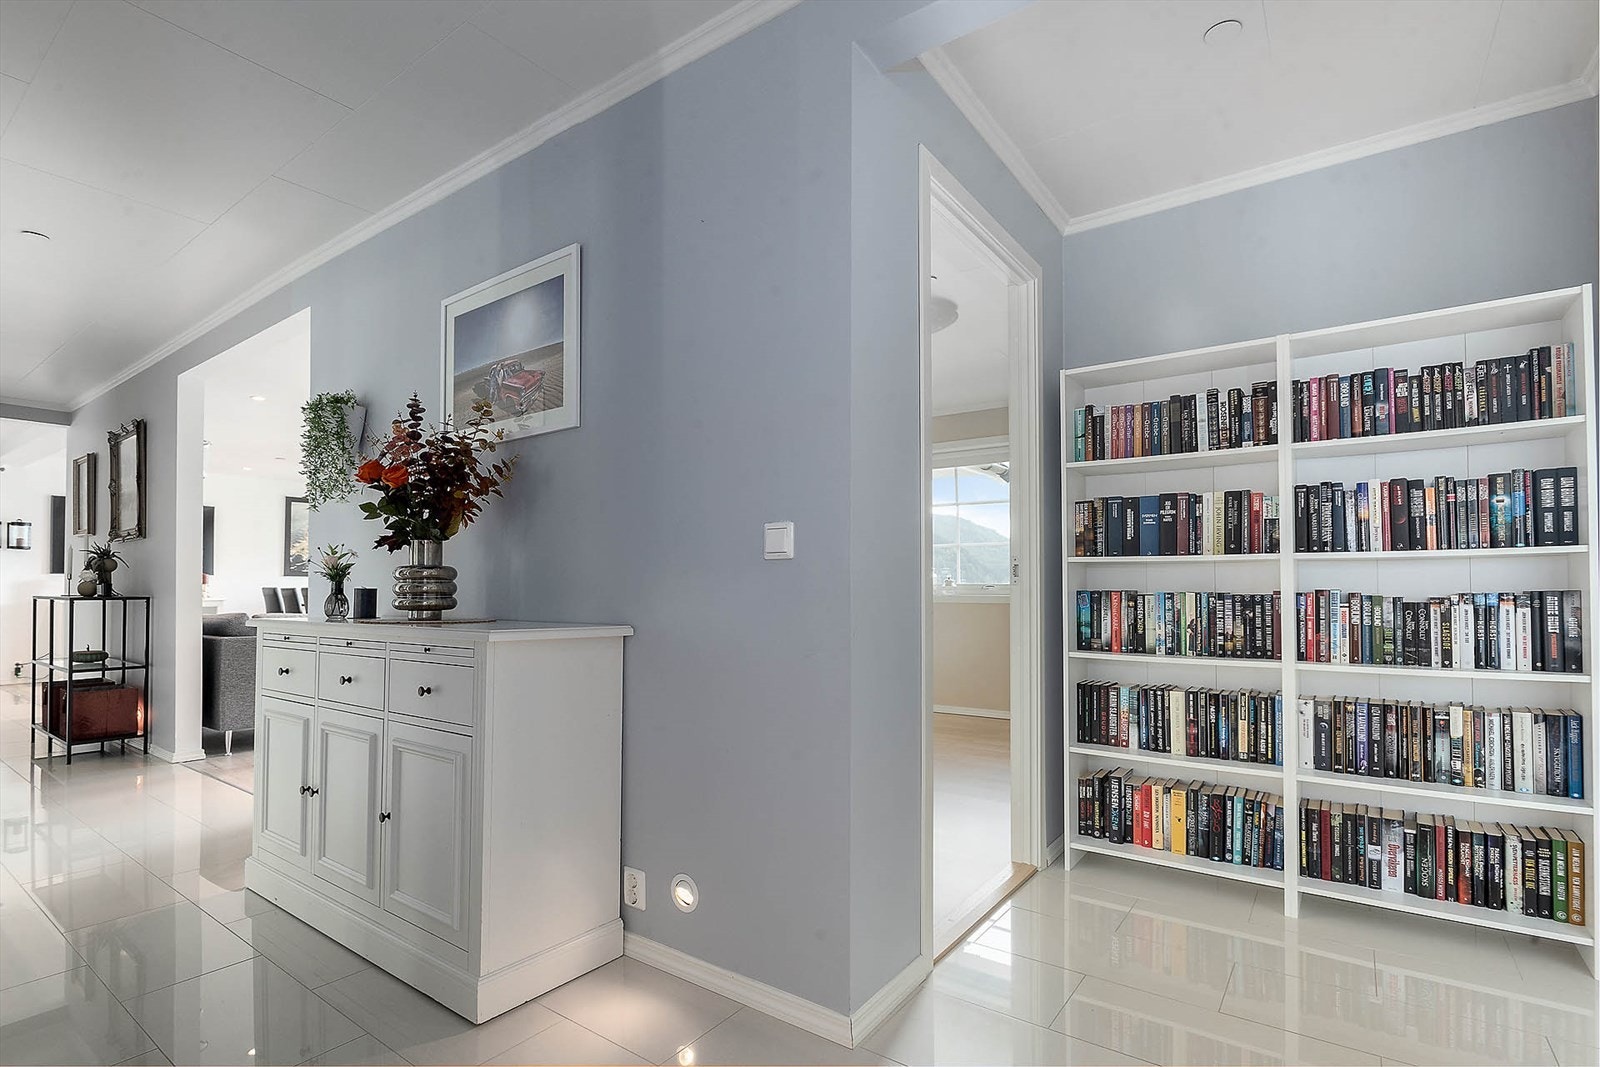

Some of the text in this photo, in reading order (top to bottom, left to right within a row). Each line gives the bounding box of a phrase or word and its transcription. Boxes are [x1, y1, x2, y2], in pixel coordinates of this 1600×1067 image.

[1477, 365, 1485, 382] FJELL
[1541, 478, 1555, 508] DAN BROWN
[1561, 477, 1575, 507] DAN BROWN
[1546, 596, 1559, 615] ANNE
[1477, 620, 1485, 641] HORST
[1489, 620, 1497, 641] HORST
[1547, 616, 1560, 634] HOLT
[1109, 708, 1118, 737] SLAUGHTER
[1371, 717, 1381, 741] MARKLUND
[1111, 781, 1119, 808] JENSEN
[1420, 858, 1430, 887] SKOGEN
